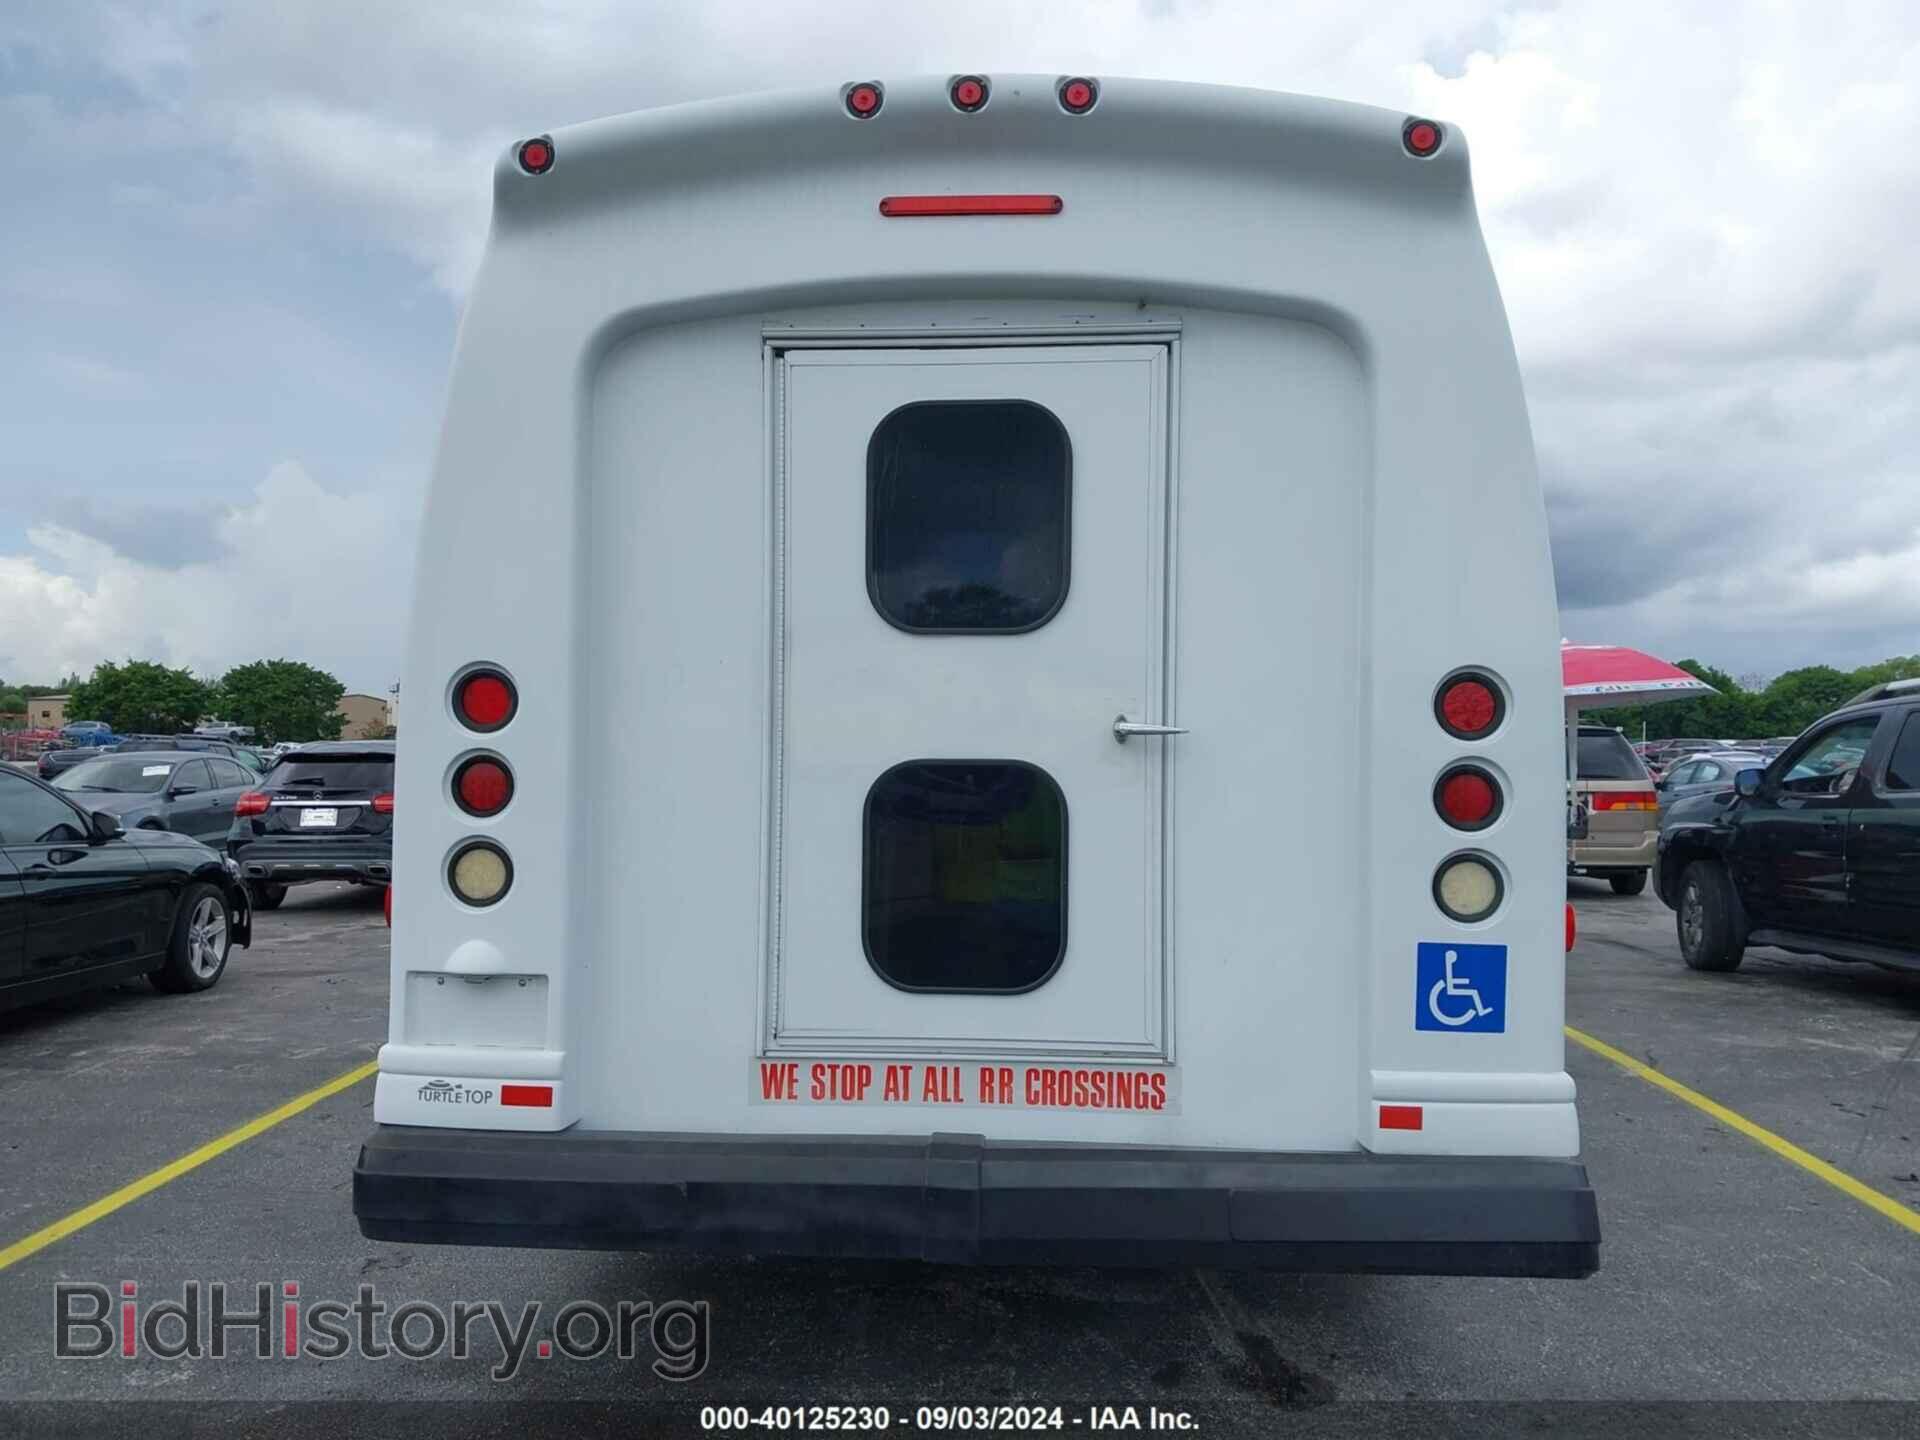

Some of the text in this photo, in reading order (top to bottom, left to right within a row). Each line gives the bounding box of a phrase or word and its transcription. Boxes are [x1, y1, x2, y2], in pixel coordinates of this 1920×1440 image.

[760, 1063, 1167, 1110] WE STOP AT ALL RR CROSSINGS
